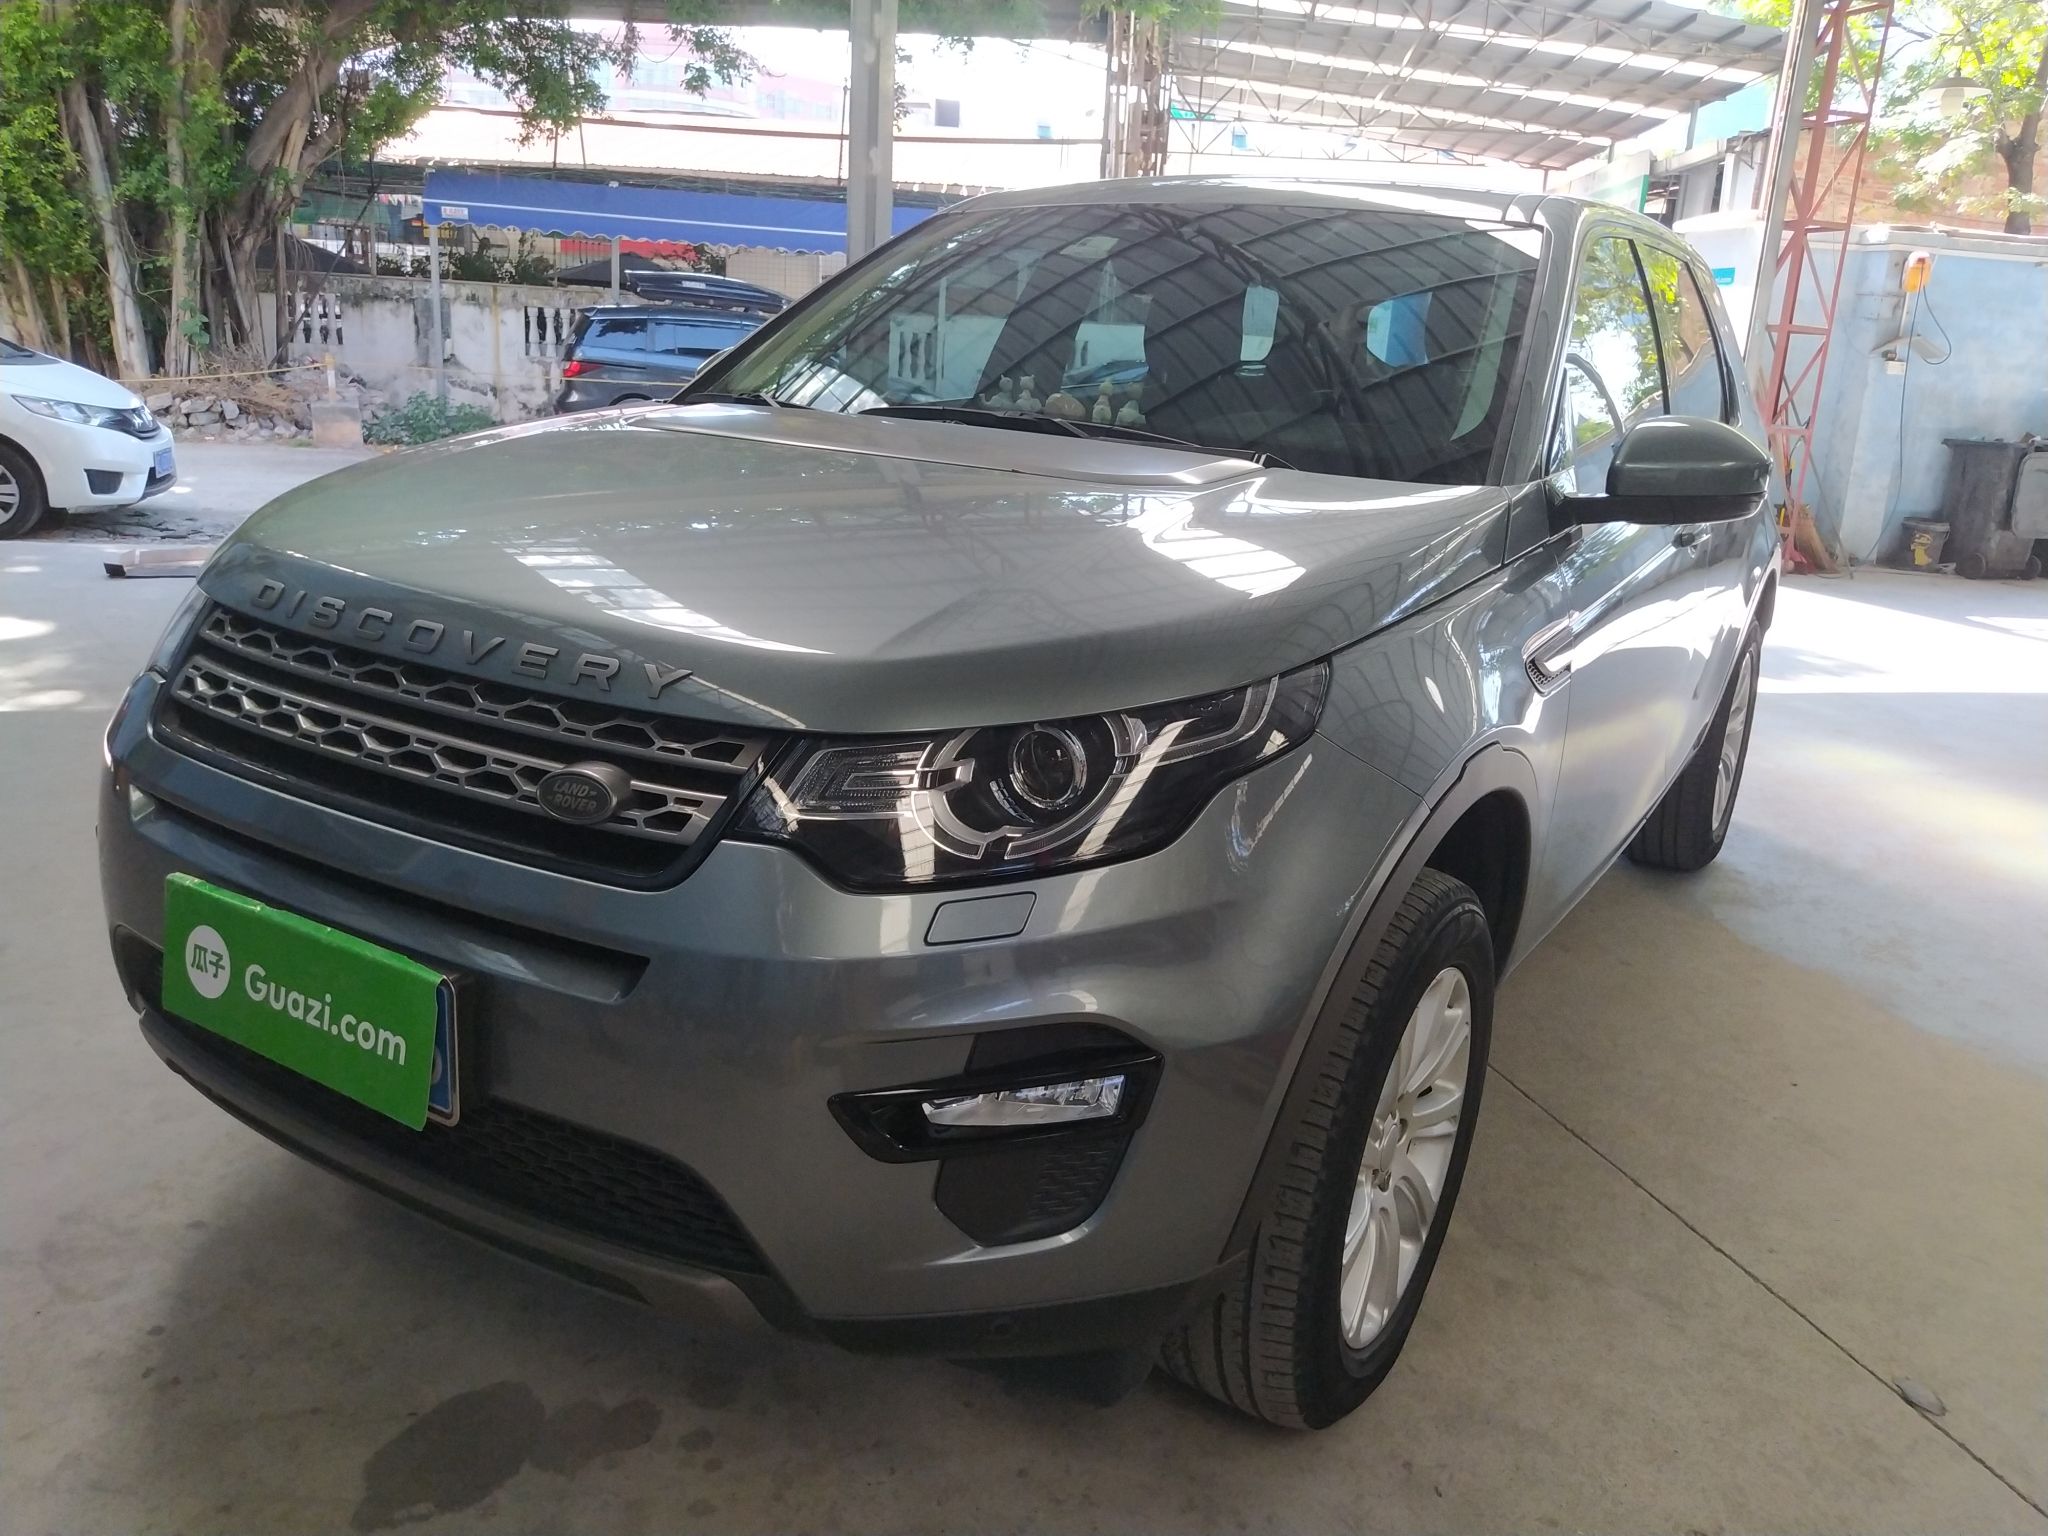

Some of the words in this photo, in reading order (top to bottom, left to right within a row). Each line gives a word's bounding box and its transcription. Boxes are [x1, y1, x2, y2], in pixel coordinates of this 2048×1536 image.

[248, 577, 694, 700] DISCOVERY
[190, 943, 226, 979] 瓜子
[244, 963, 407, 1066] Guazi.com
